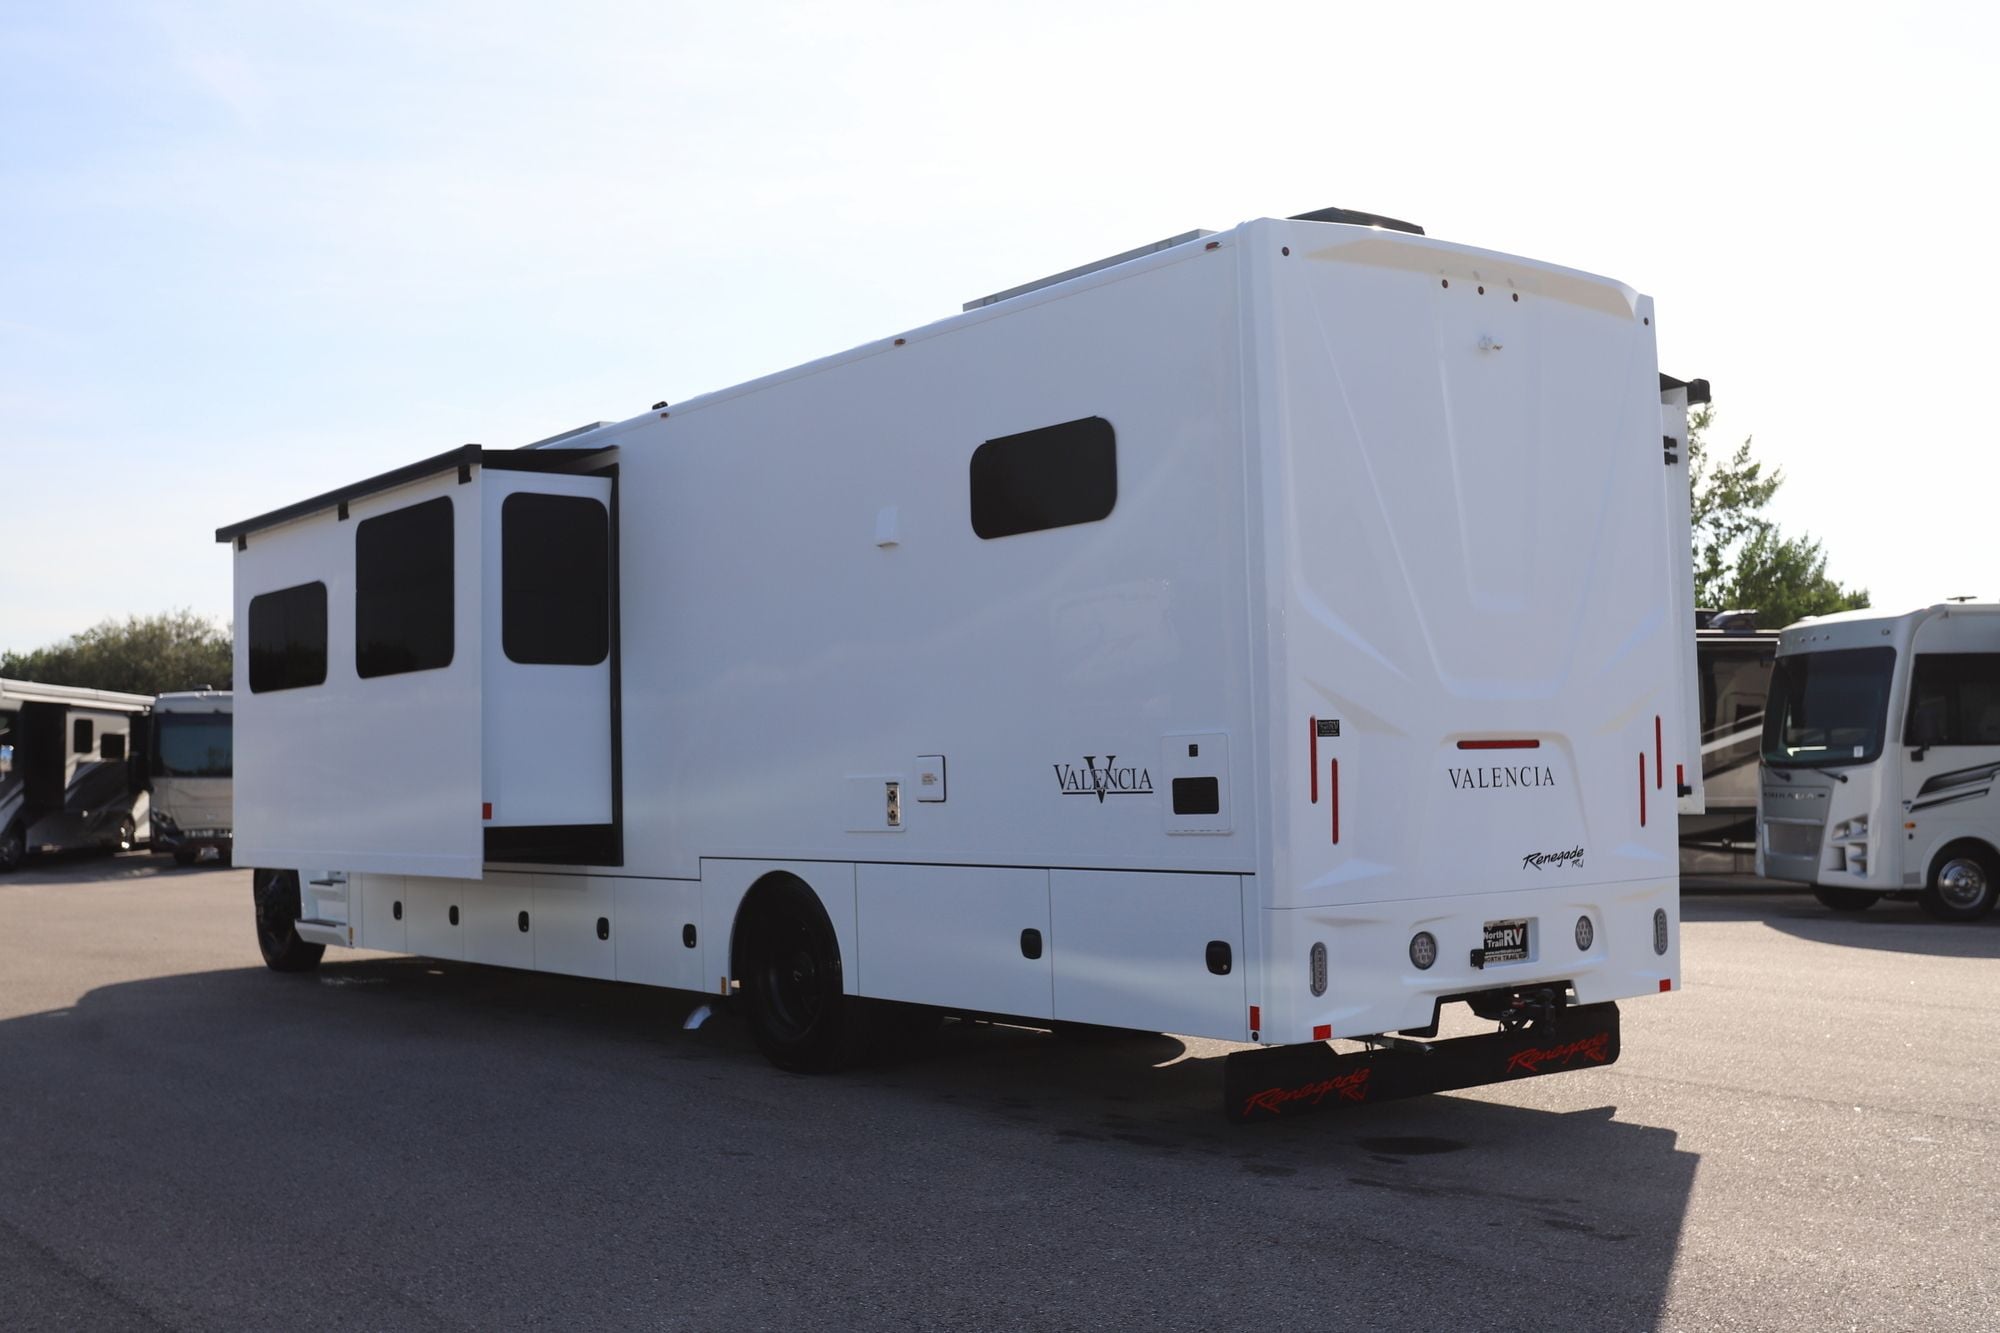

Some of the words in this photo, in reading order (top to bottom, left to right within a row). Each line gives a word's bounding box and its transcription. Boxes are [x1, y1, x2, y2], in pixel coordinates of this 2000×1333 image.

[1053, 764, 1153, 791] VALENCIA
[1448, 766, 1555, 789] VALENCIA
[1522, 844, 1584, 871] Renegade
[1483, 931, 1503, 940] North
[1486, 939, 1504, 948] Trail
[1503, 928, 1523, 946] RV
[1506, 1033, 1609, 1073] Renegade
[1243, 1067, 1370, 1115] Renegade
